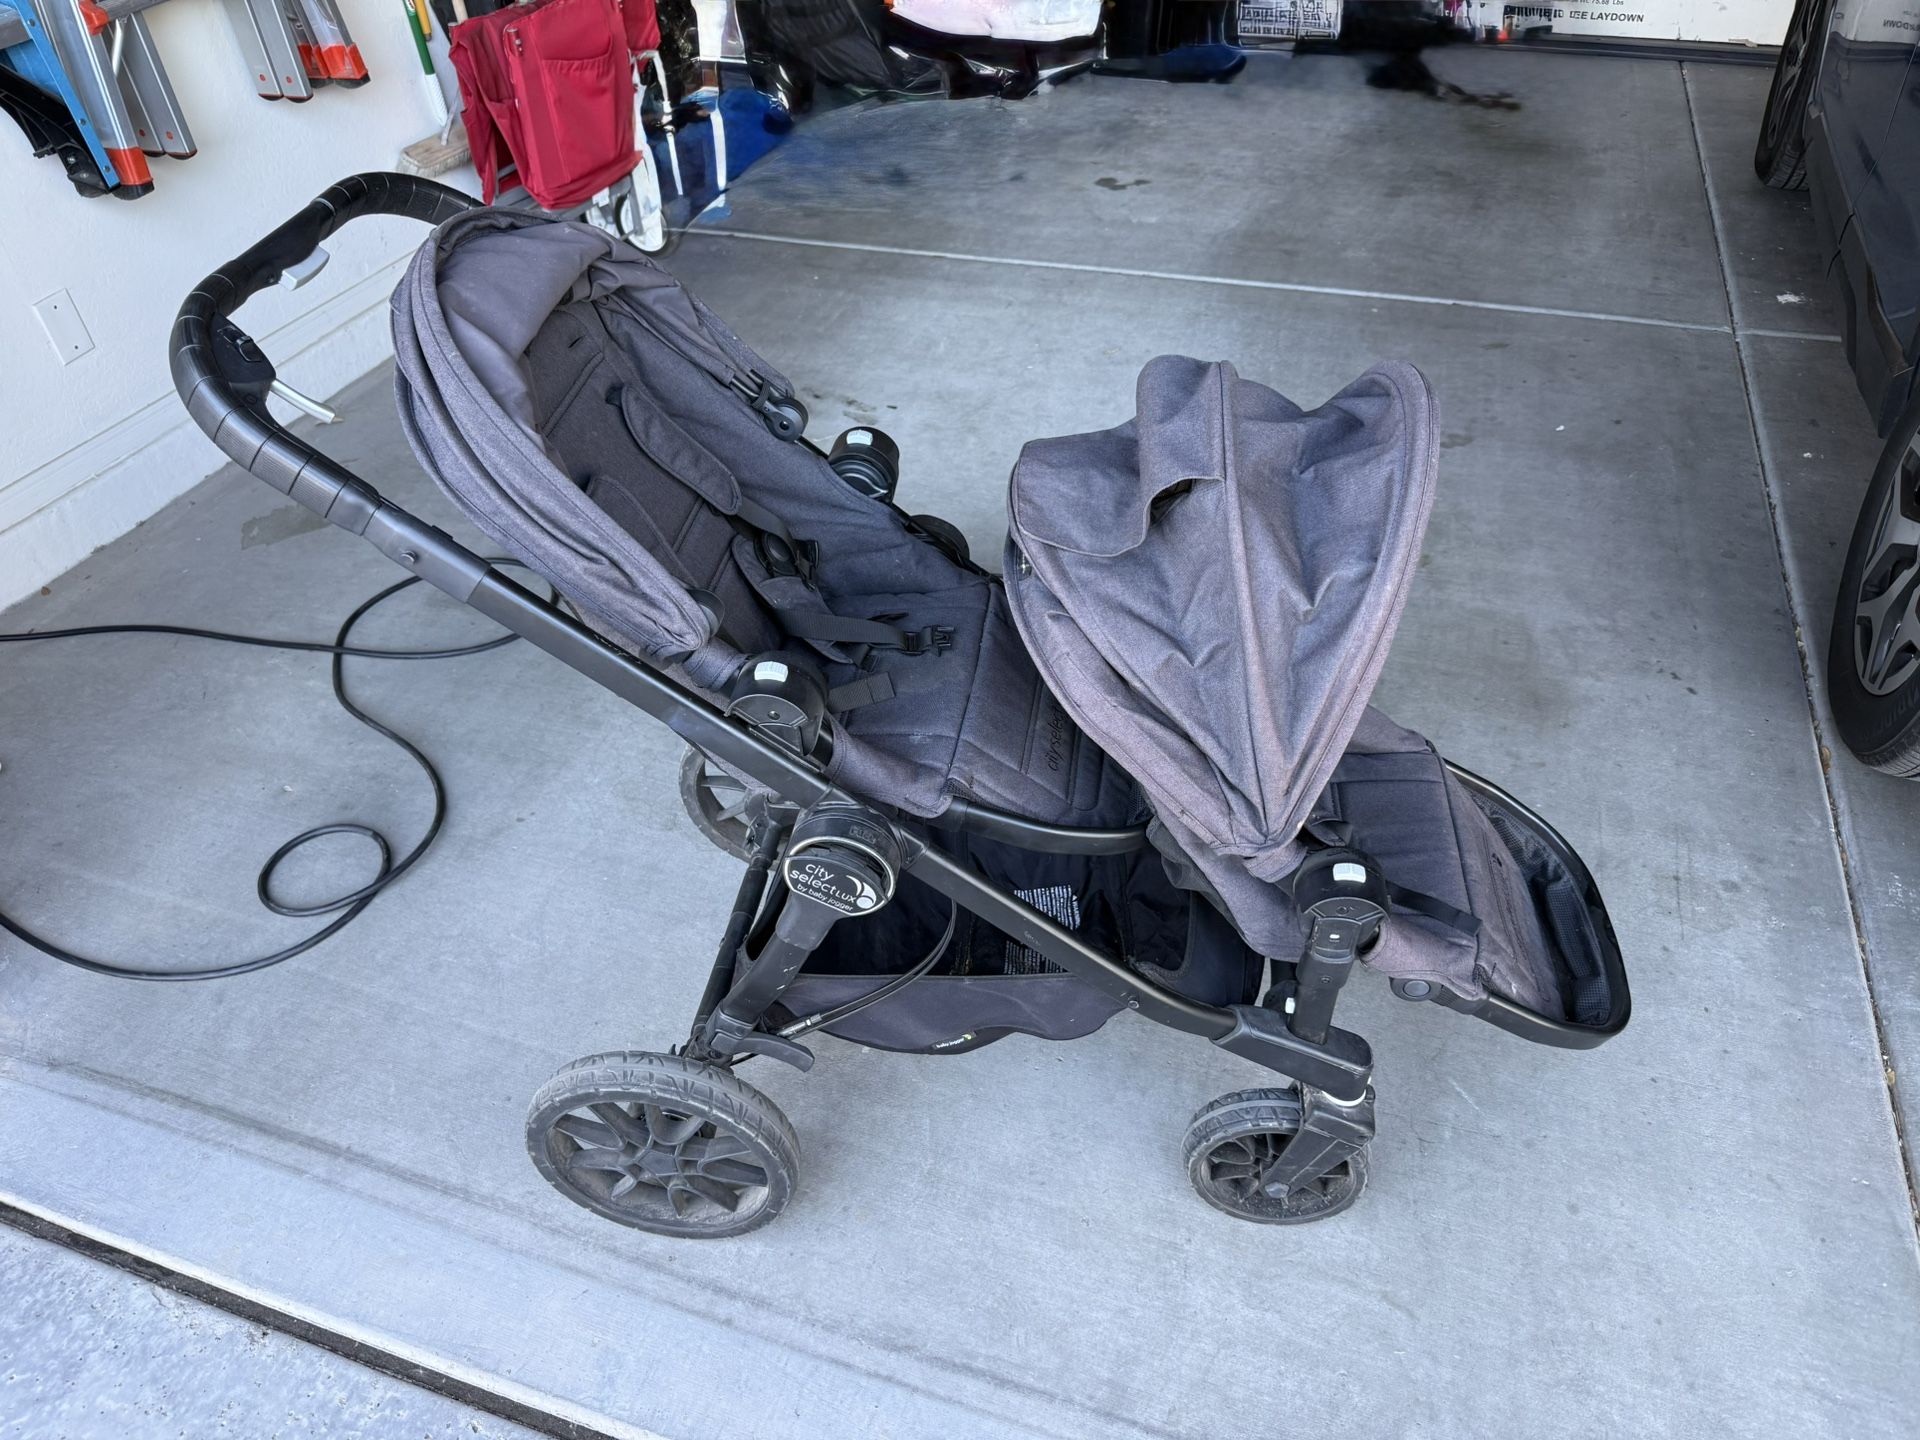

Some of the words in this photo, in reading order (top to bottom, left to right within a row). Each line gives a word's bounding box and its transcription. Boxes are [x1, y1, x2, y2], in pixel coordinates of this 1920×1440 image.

[1590, 12, 1645, 22] LAYDOWN
[805, 863, 835, 881] city
[796, 884, 807, 893] by
[808, 888, 828, 901] baby
[827, 898, 854, 912] jogger
